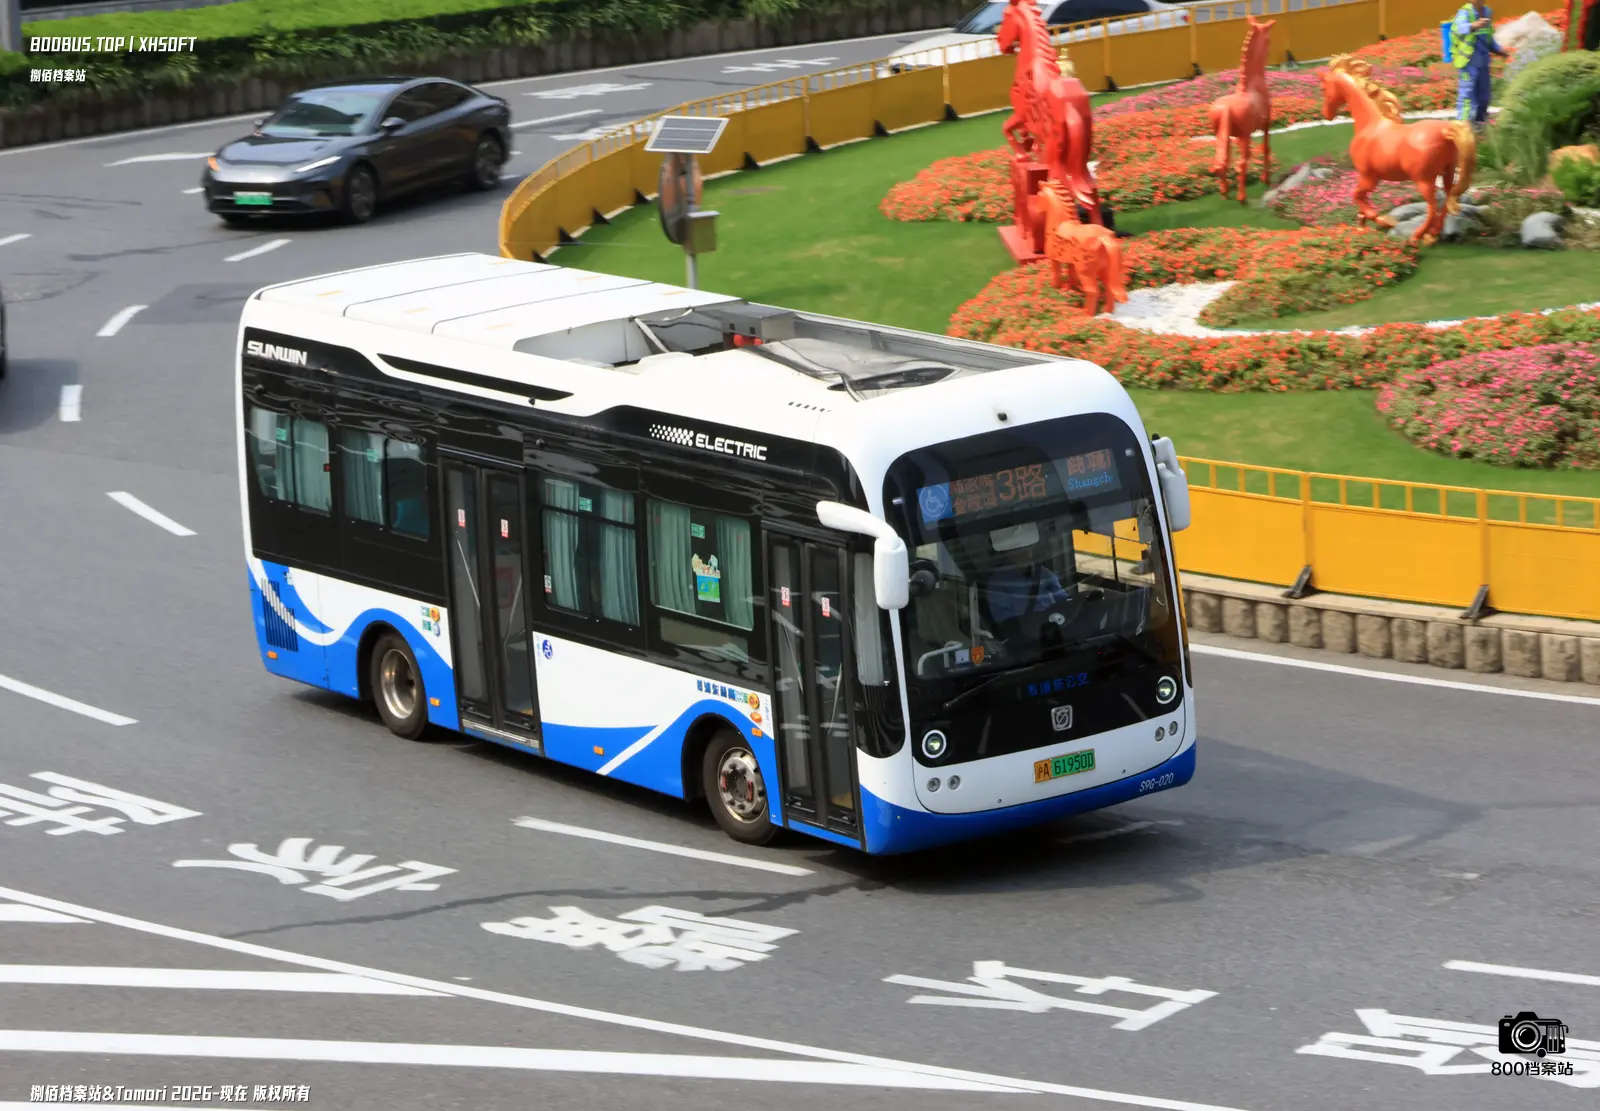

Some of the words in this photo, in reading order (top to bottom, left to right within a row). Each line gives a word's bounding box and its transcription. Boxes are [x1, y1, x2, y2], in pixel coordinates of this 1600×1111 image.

[247, 340, 307, 366] SUNWIN
[695, 433, 768, 460] ELECTRIC
[996, 464, 1047, 501] 3路
